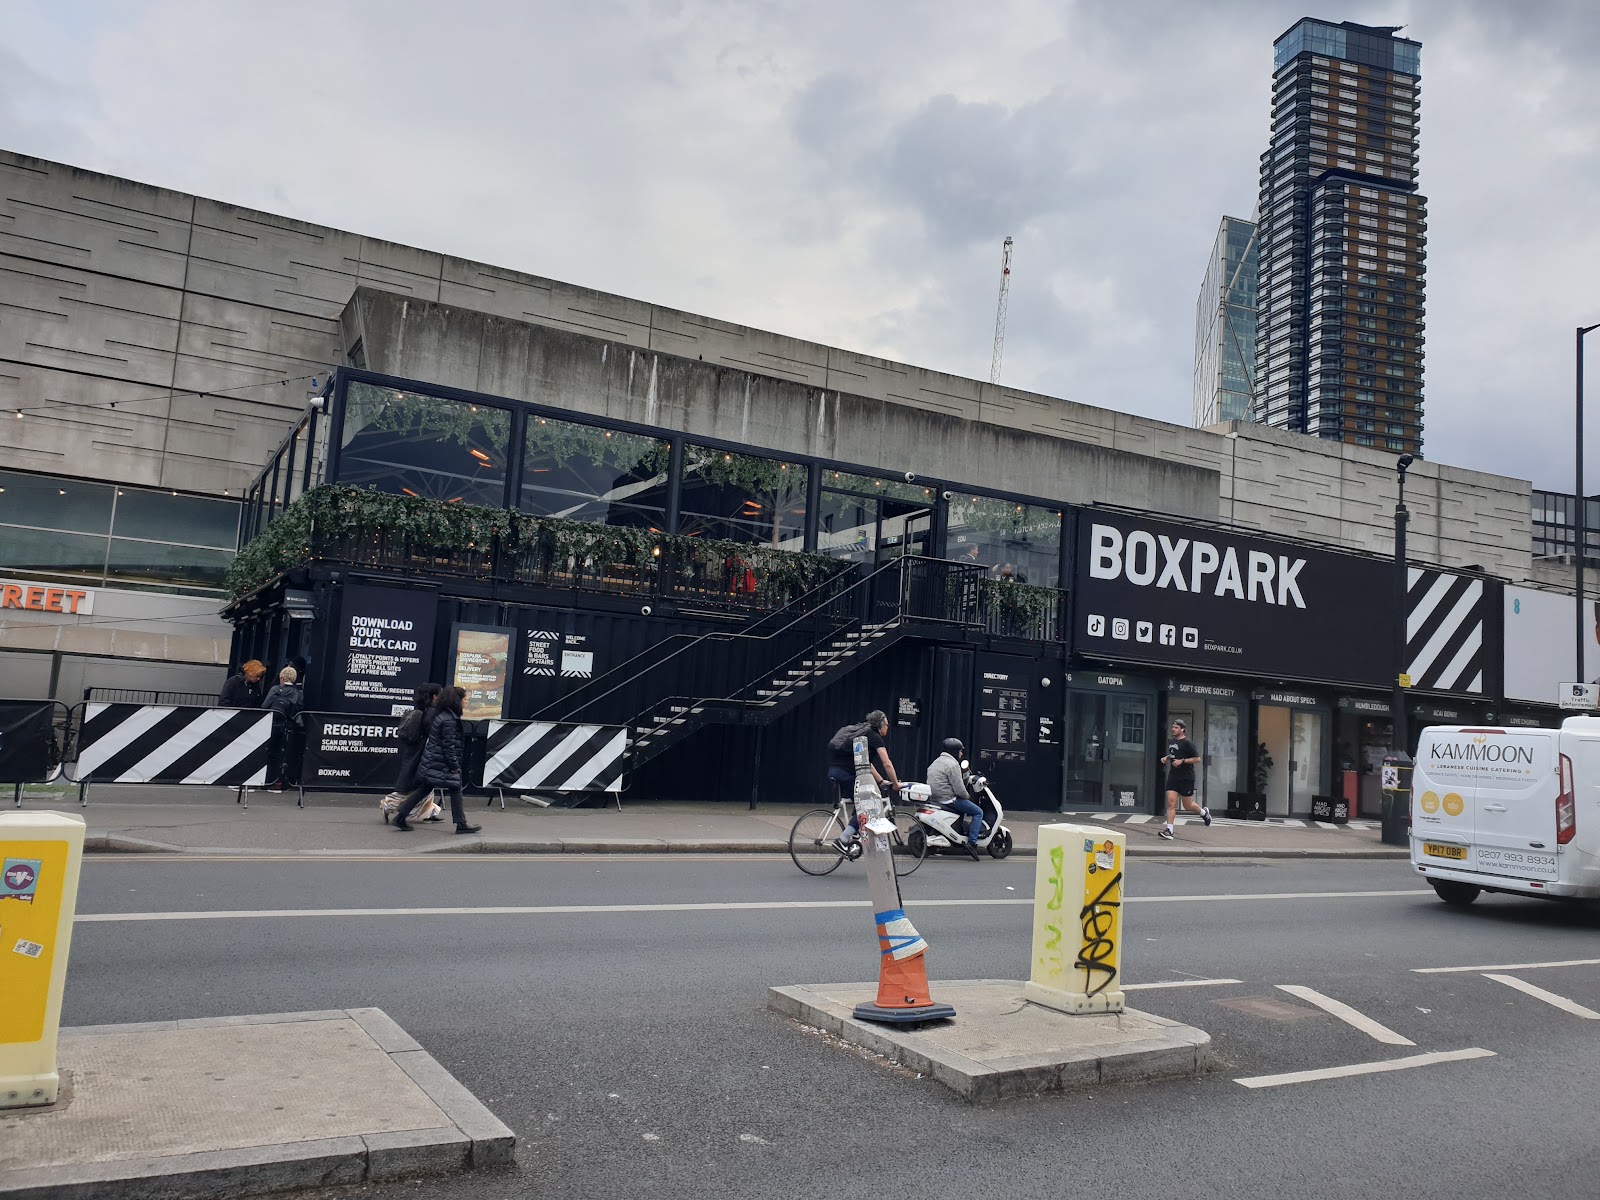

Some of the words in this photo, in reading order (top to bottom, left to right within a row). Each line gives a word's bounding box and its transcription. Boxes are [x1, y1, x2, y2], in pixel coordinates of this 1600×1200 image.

[1090, 523, 1307, 609] BOXPARK
[0, 584, 87, 613] REET
[352, 616, 413, 630] DOWNLOAD
[351, 626, 382, 638] YOUR
[350, 636, 386, 649] BLACK
[388, 639, 417, 651] CARD
[529, 641, 550, 649] STREET
[1204, 643, 1243, 654] BOXPARK.CO.UK
[375, 654, 394, 662] POINTS
[528, 657, 554, 665] UPSTAIRS
[983, 672, 1009, 680] DIRECTORY
[1097, 676, 1123, 686] OATOPIA
[344, 685, 415, 695] BOXPARK.CO.UK/REGISTER
[1179, 684, 1194, 693] SOFT
[1194, 685, 1212, 695] SERVE
[1212, 687, 1235, 697] SOCIETY
[1283, 695, 1300, 703] ABOUT
[1300, 696, 1316, 705] SPECS
[323, 724, 384, 738] REGISTER
[321, 745, 399, 754] BOXPARK.CO.UK/REGISTER
[1431, 743, 1533, 764] KAMMOON
[318, 769, 351, 777] BOXPARK
[1427, 844, 1445, 854] YP17
[1478, 849, 1501, 860] 0207
[1504, 852, 1524, 863] 993
[1527, 855, 1555, 865] 8934
[1478, 860, 1557, 874] www.kammoon.co.uk
